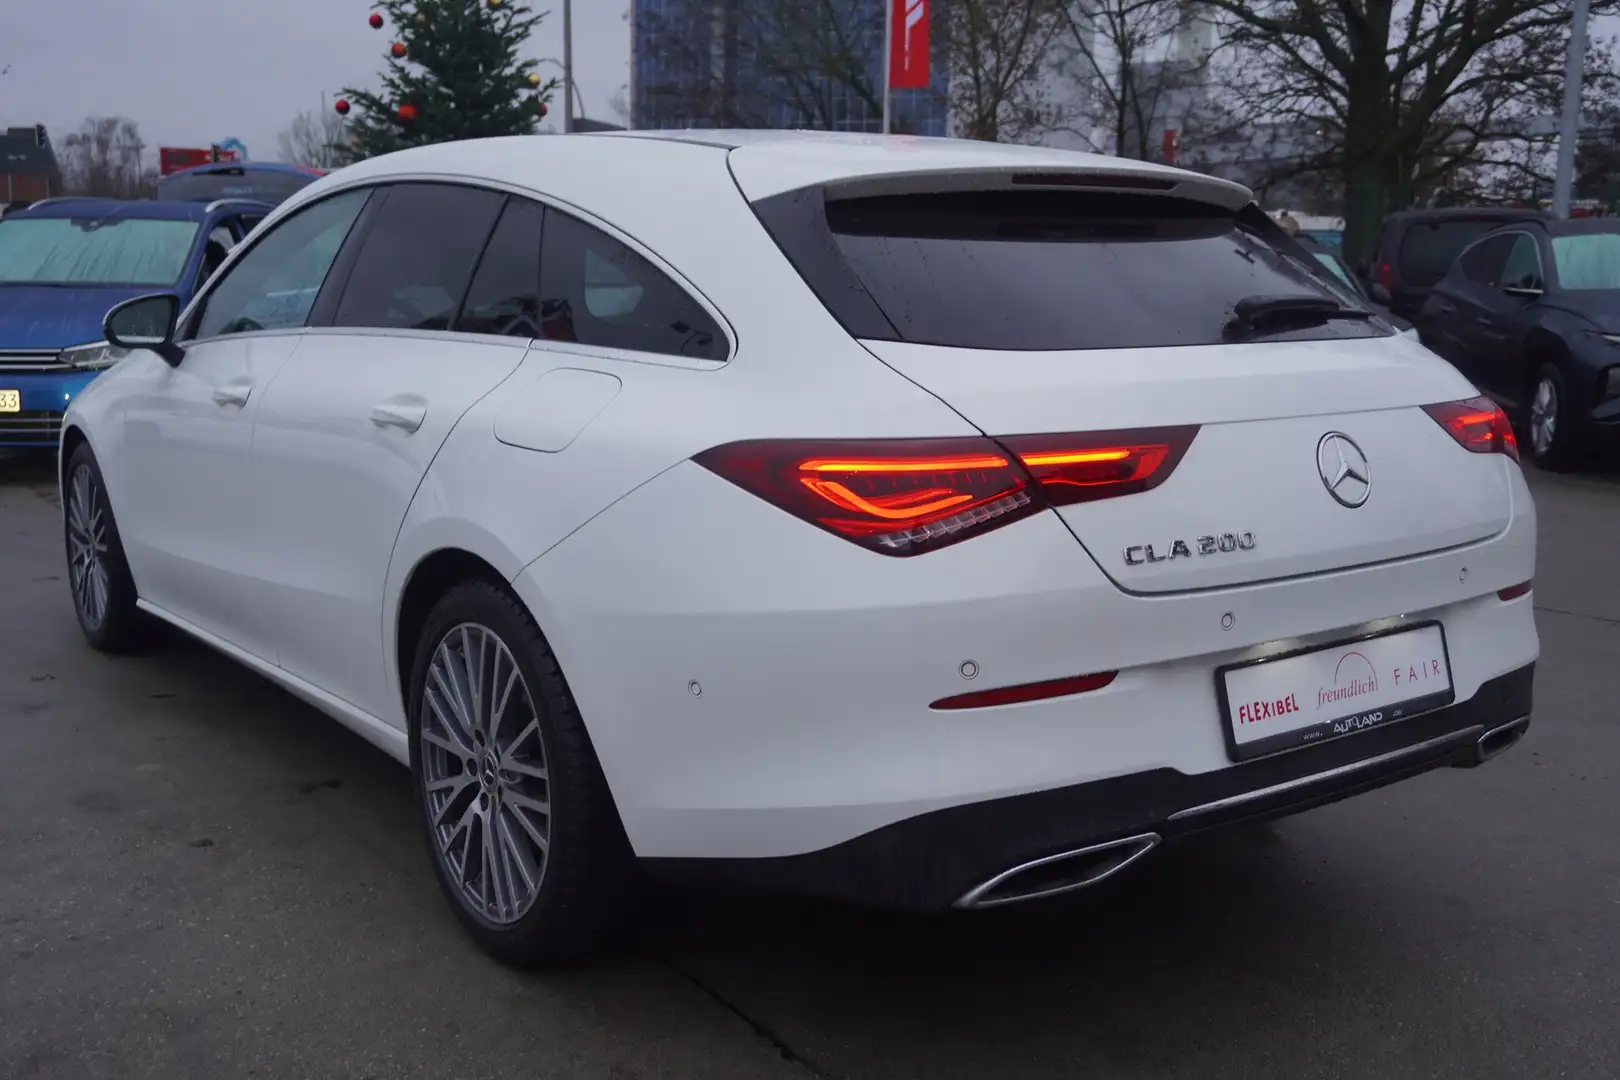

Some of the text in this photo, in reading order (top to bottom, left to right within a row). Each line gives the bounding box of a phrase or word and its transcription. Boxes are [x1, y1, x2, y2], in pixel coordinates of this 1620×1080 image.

[1123, 531, 1256, 566] CLA 200
[1239, 660, 1441, 725] FLEXIBEL freundlich FAIR
